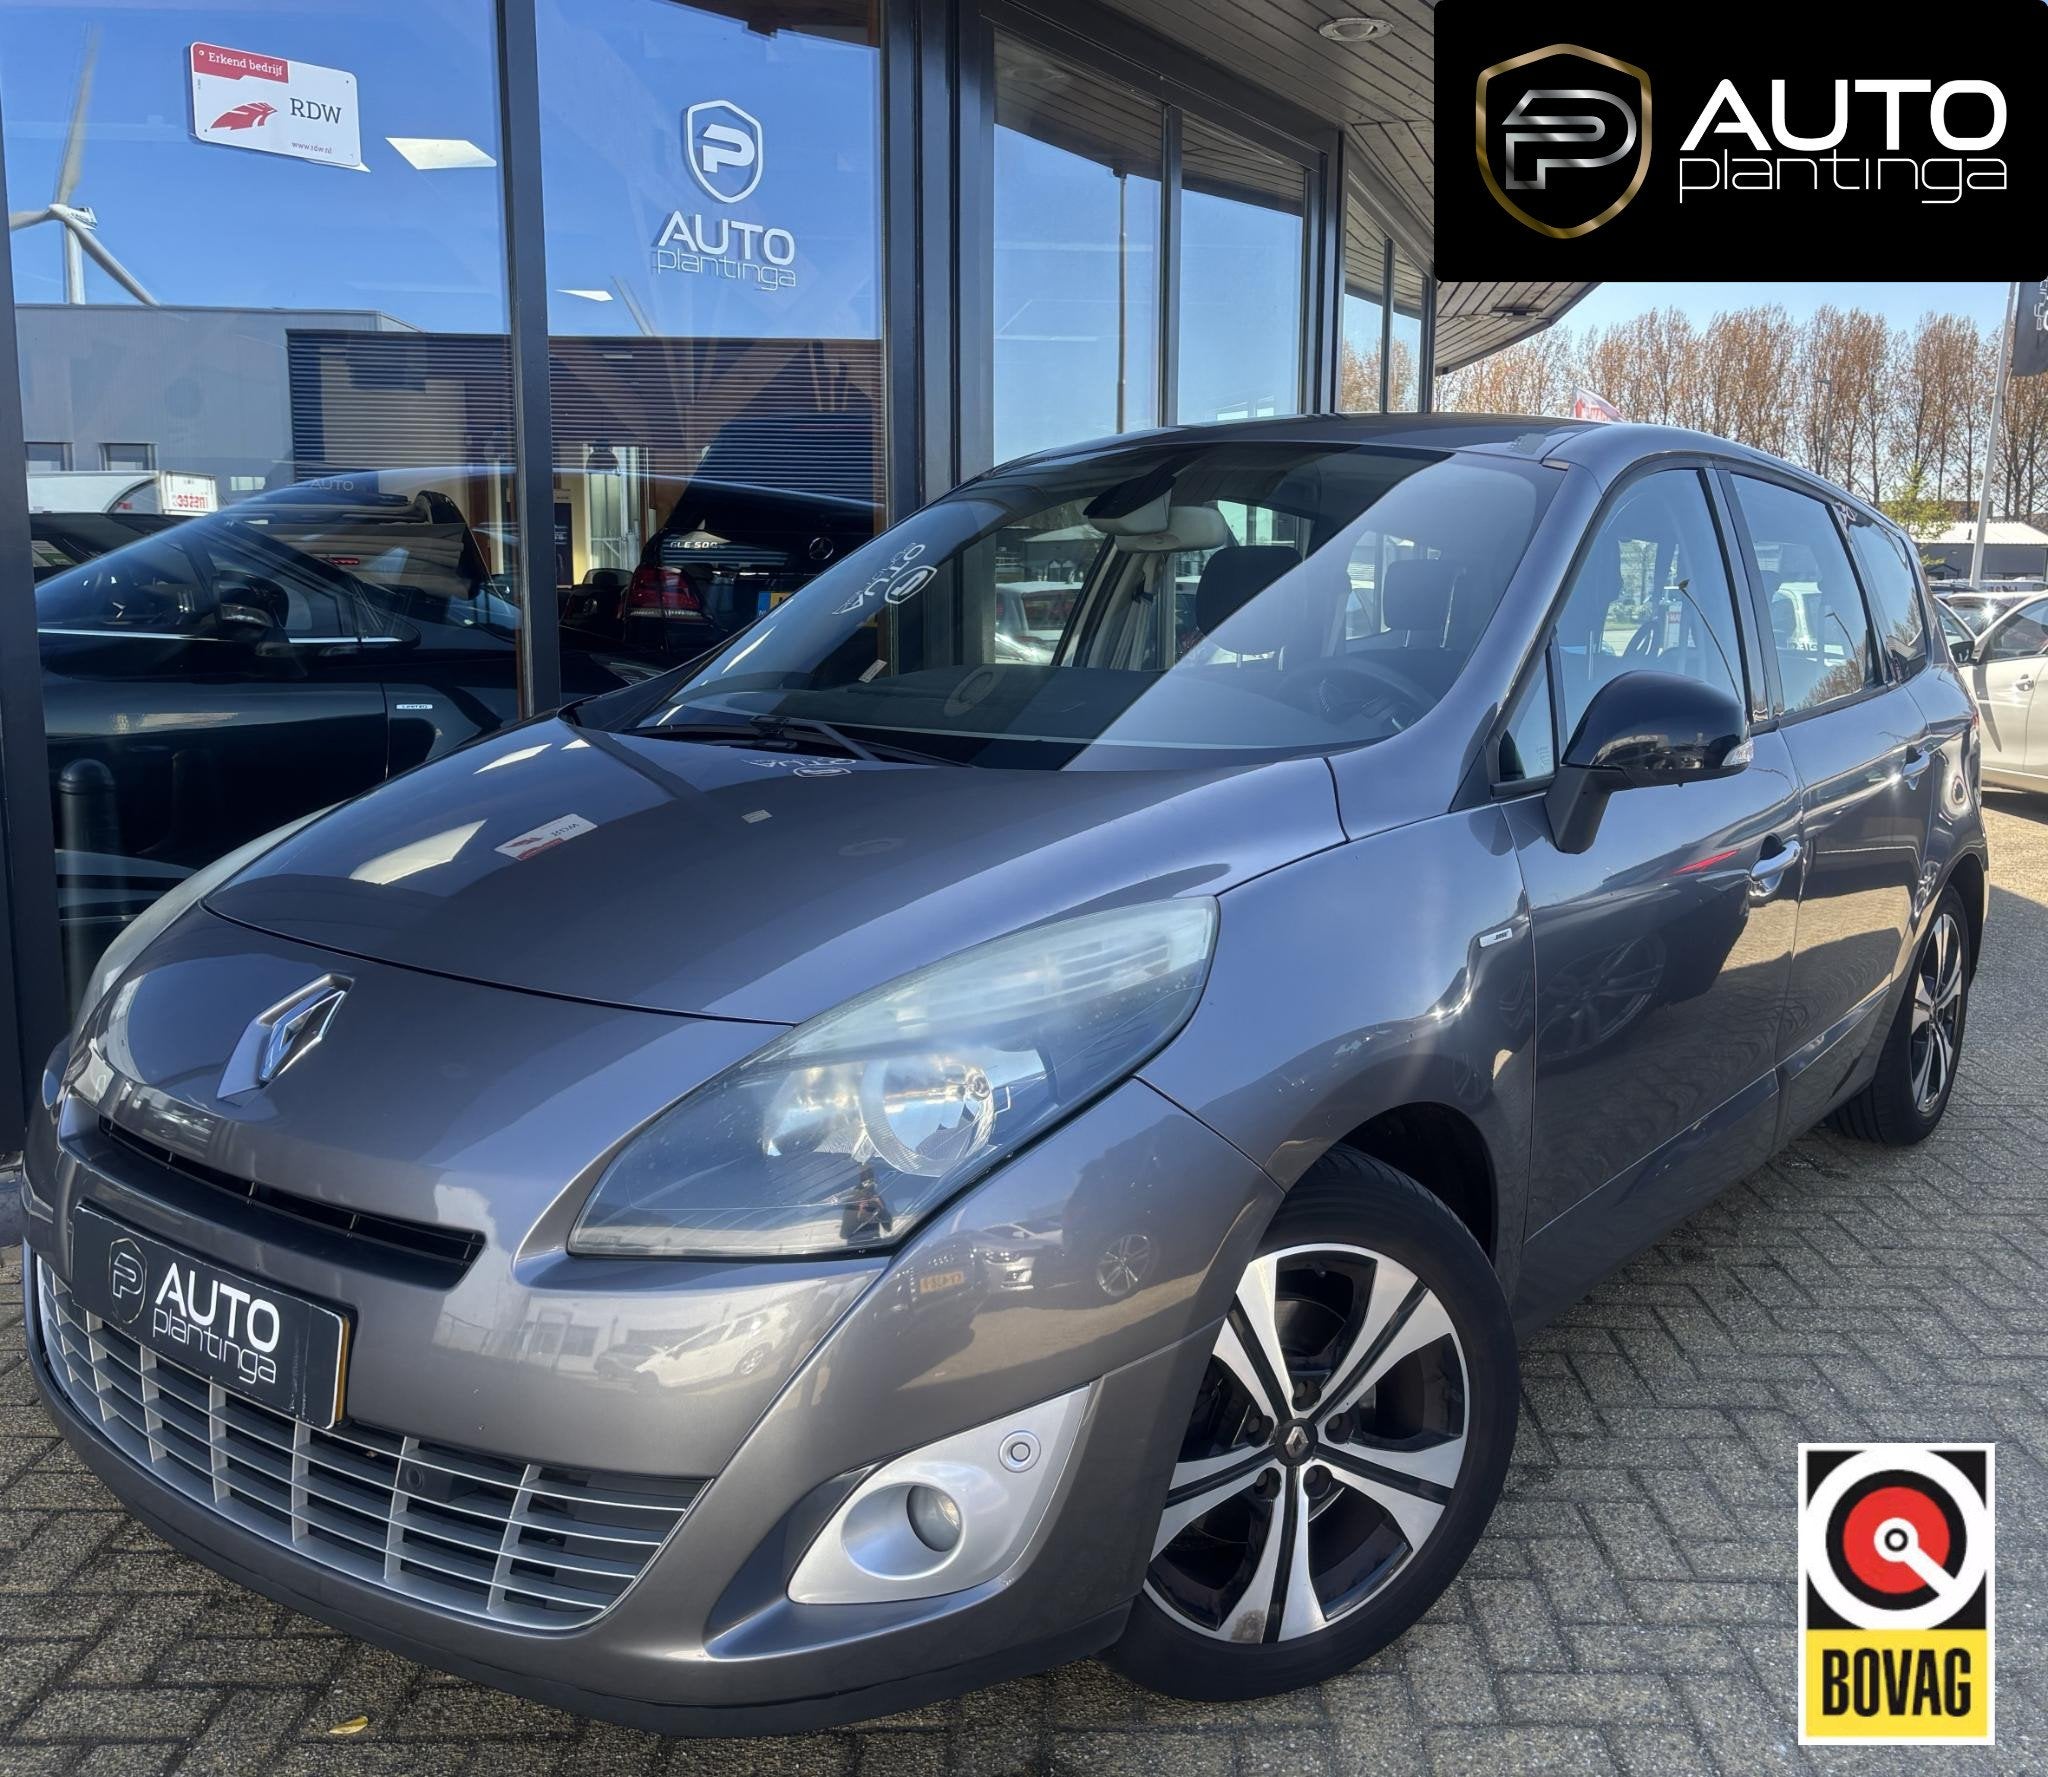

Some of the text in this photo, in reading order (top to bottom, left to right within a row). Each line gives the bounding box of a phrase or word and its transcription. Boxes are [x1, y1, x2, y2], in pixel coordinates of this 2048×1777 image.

[208, 51, 283, 77] Erkend bedrijf
[290, 97, 342, 125] RDW
[657, 210, 796, 266] AUTO
[656, 247, 796, 291] plantinga
[155, 1262, 280, 1353] AUTO
[152, 1308, 277, 1385] plantinga
